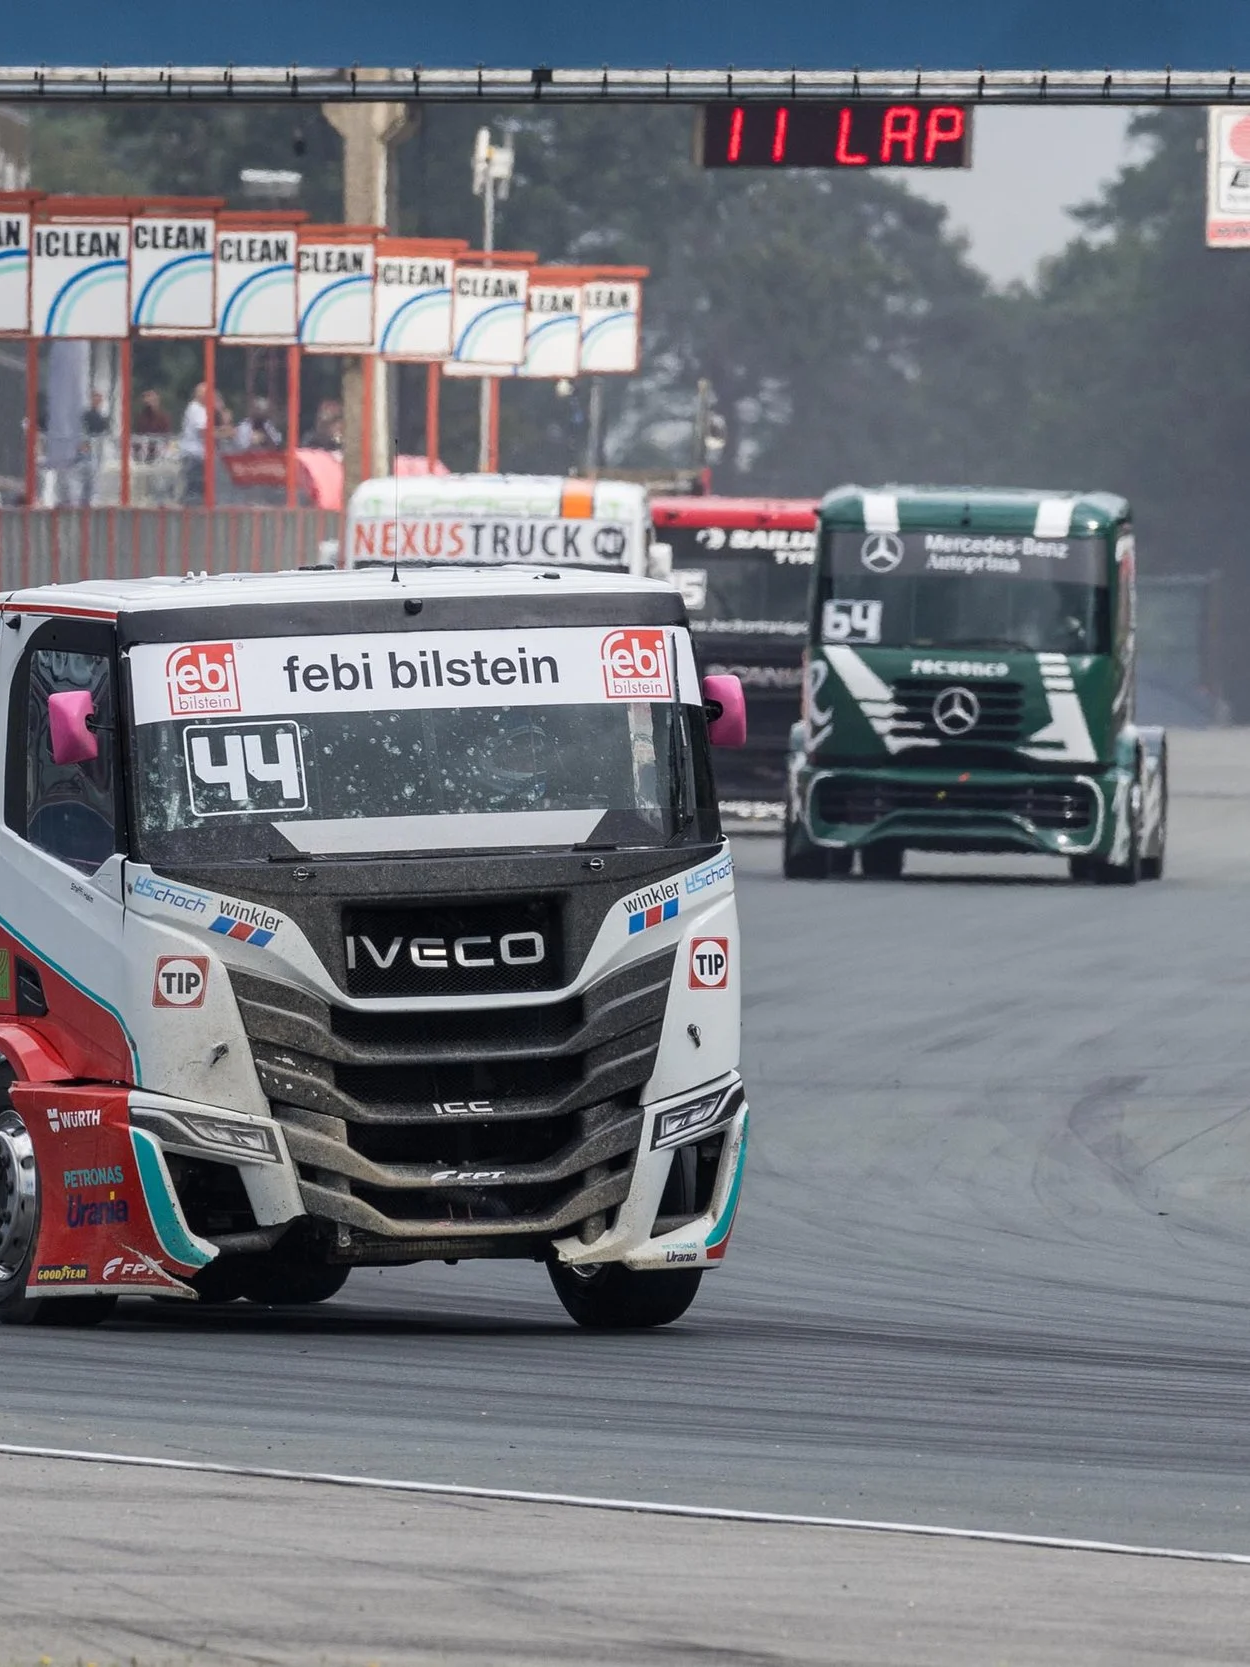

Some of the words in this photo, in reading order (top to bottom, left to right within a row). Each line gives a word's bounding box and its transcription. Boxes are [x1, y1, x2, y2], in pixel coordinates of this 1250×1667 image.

[836, 107, 965, 165] LAP
[36, 231, 121, 257] ICLEAN
[134, 225, 206, 250] CLEAN
[219, 238, 288, 263] CLEAN
[298, 251, 364, 273] CLEAN
[601, 632, 665, 679] febi
[166, 646, 235, 694] febi
[283, 652, 373, 693] febi
[388, 646, 559, 689] bilstein
[613, 680, 664, 695] bilstein
[178, 695, 233, 711] bilstein
[191, 733, 300, 801] 44
[623, 882, 680, 914] winkler
[220, 900, 283, 932] winkler
[347, 931, 545, 969] IVECO
[696, 953, 725, 976] TIP
[162, 972, 201, 994] TIP
[433, 1101, 493, 1114] ICC
[64, 1166, 124, 1189] PETRONAS
[456, 1171, 505, 1180] FPT
[66, 1191, 129, 1228] Urania
[666, 1251, 698, 1262] Urania
[37, 1265, 87, 1280] GOODYEAR
